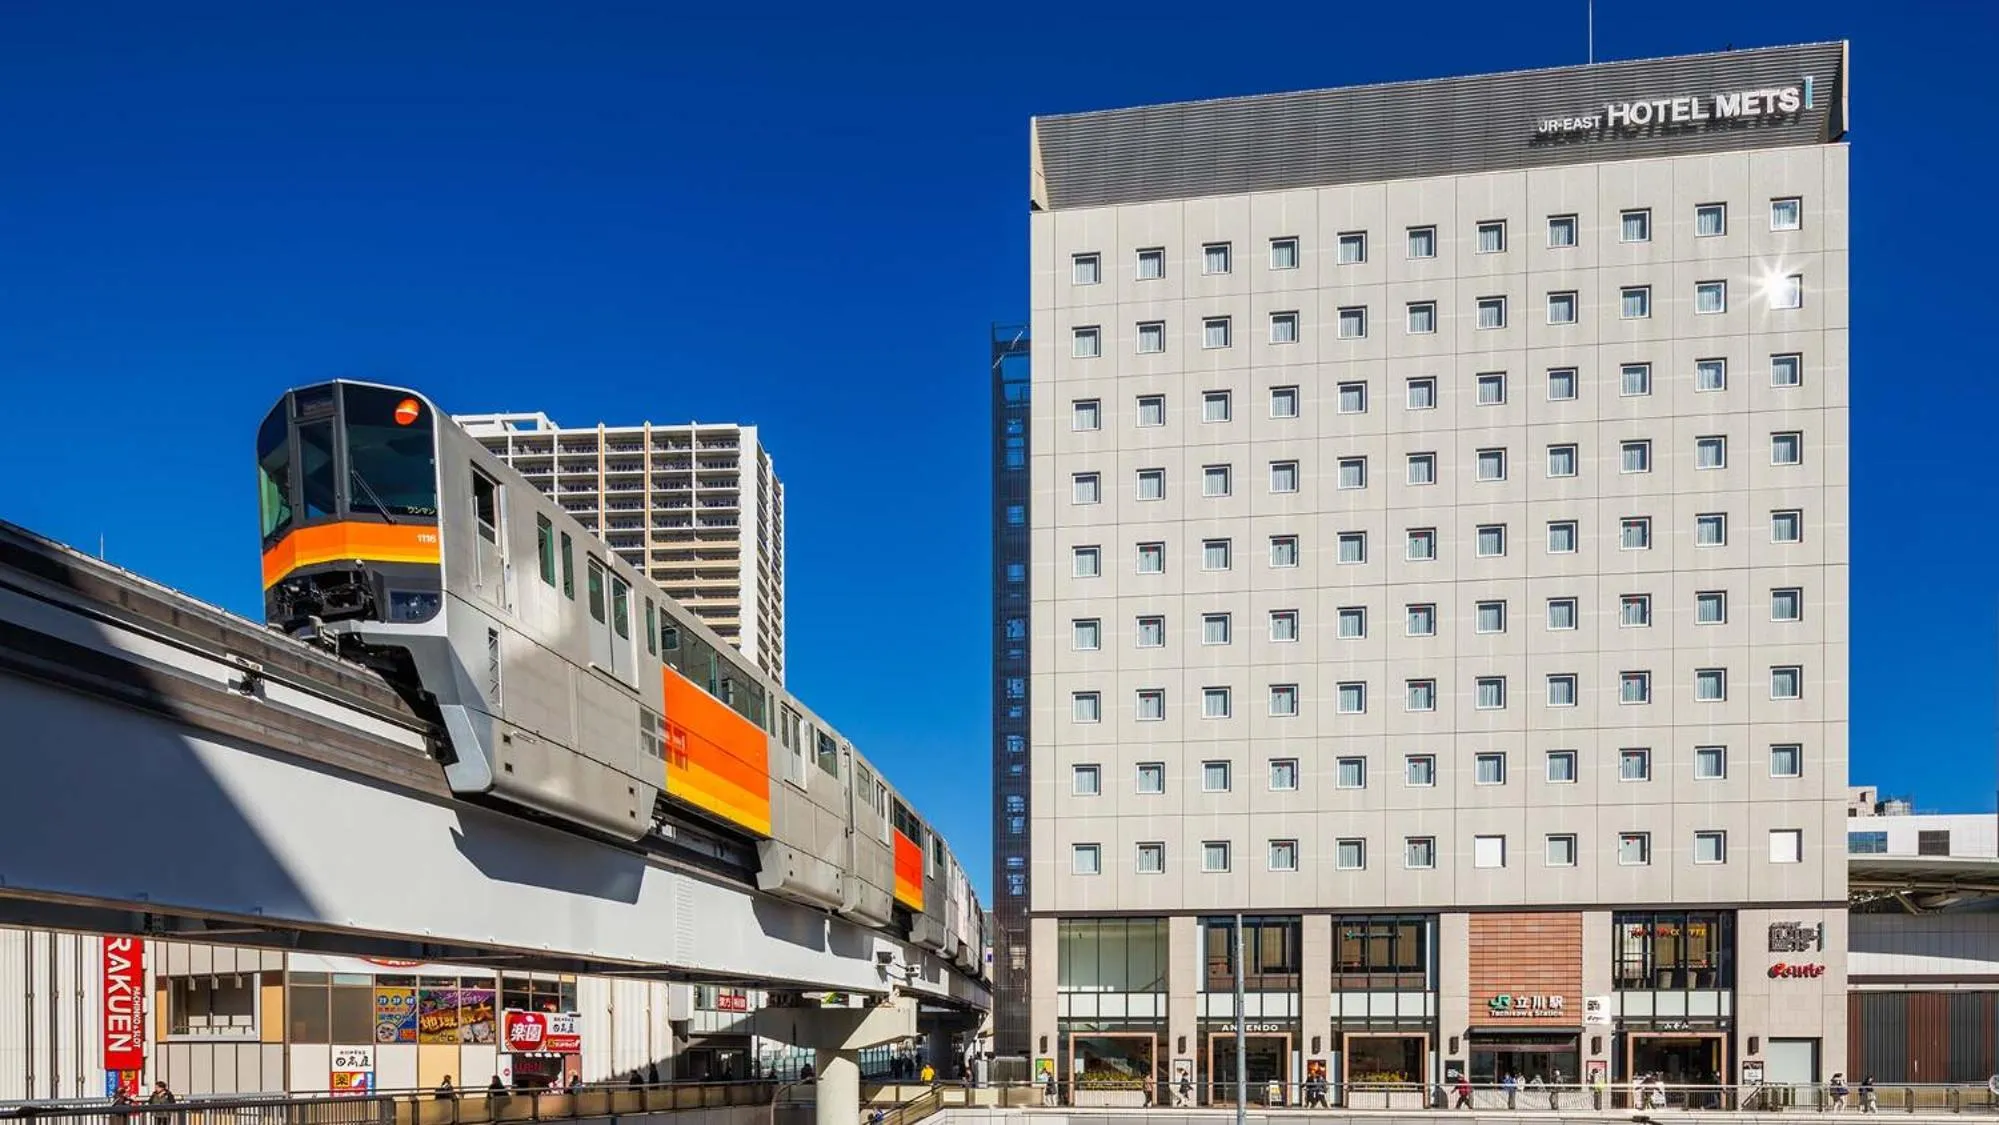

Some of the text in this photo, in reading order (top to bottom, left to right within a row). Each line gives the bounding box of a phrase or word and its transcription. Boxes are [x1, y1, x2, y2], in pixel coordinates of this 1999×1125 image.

[1538, 87, 1800, 133] JR-EAST HOTEL METS
[407, 506, 436, 515] ワンマン
[107, 937, 132, 1052] RAKUEN
[1513, 994, 1563, 1010] 立川駅
